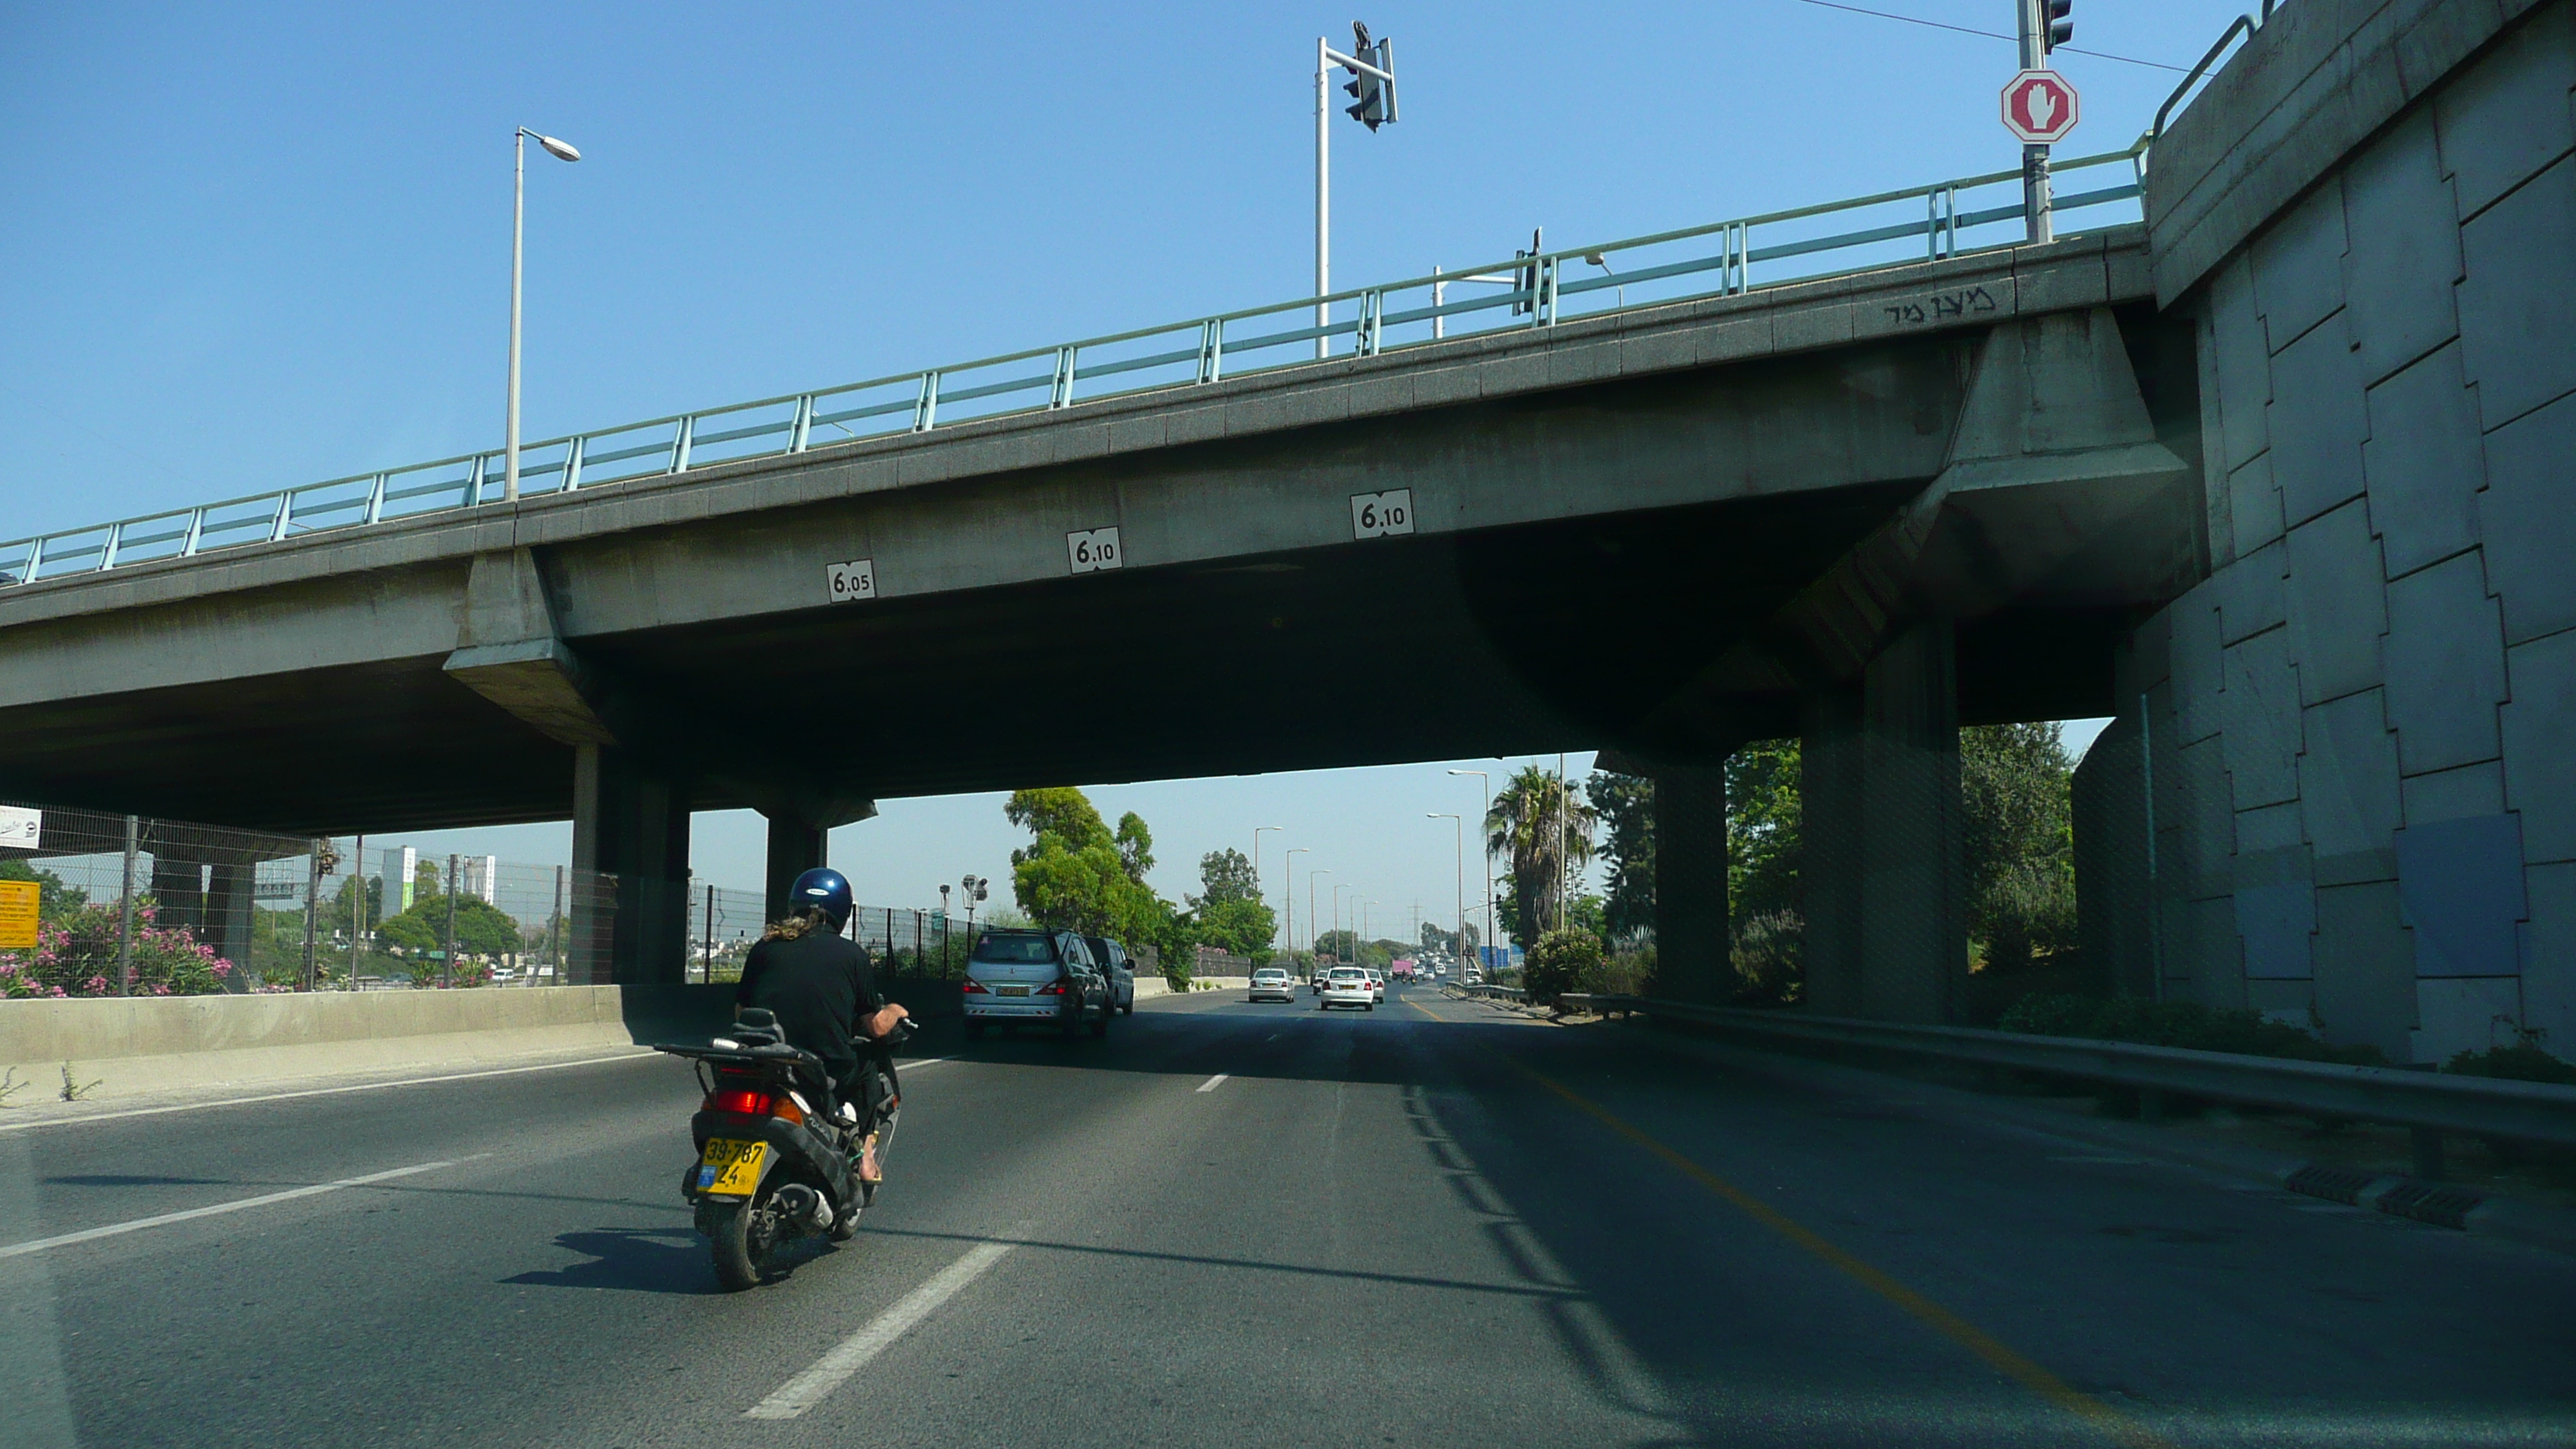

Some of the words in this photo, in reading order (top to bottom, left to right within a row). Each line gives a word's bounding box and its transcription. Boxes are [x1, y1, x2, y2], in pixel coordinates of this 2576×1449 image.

[1361, 502, 1405, 529] 6.10
[1076, 540, 1114, 564] 6.10
[834, 571, 869, 594] 6.05
[718, 1164, 740, 1185] 24
